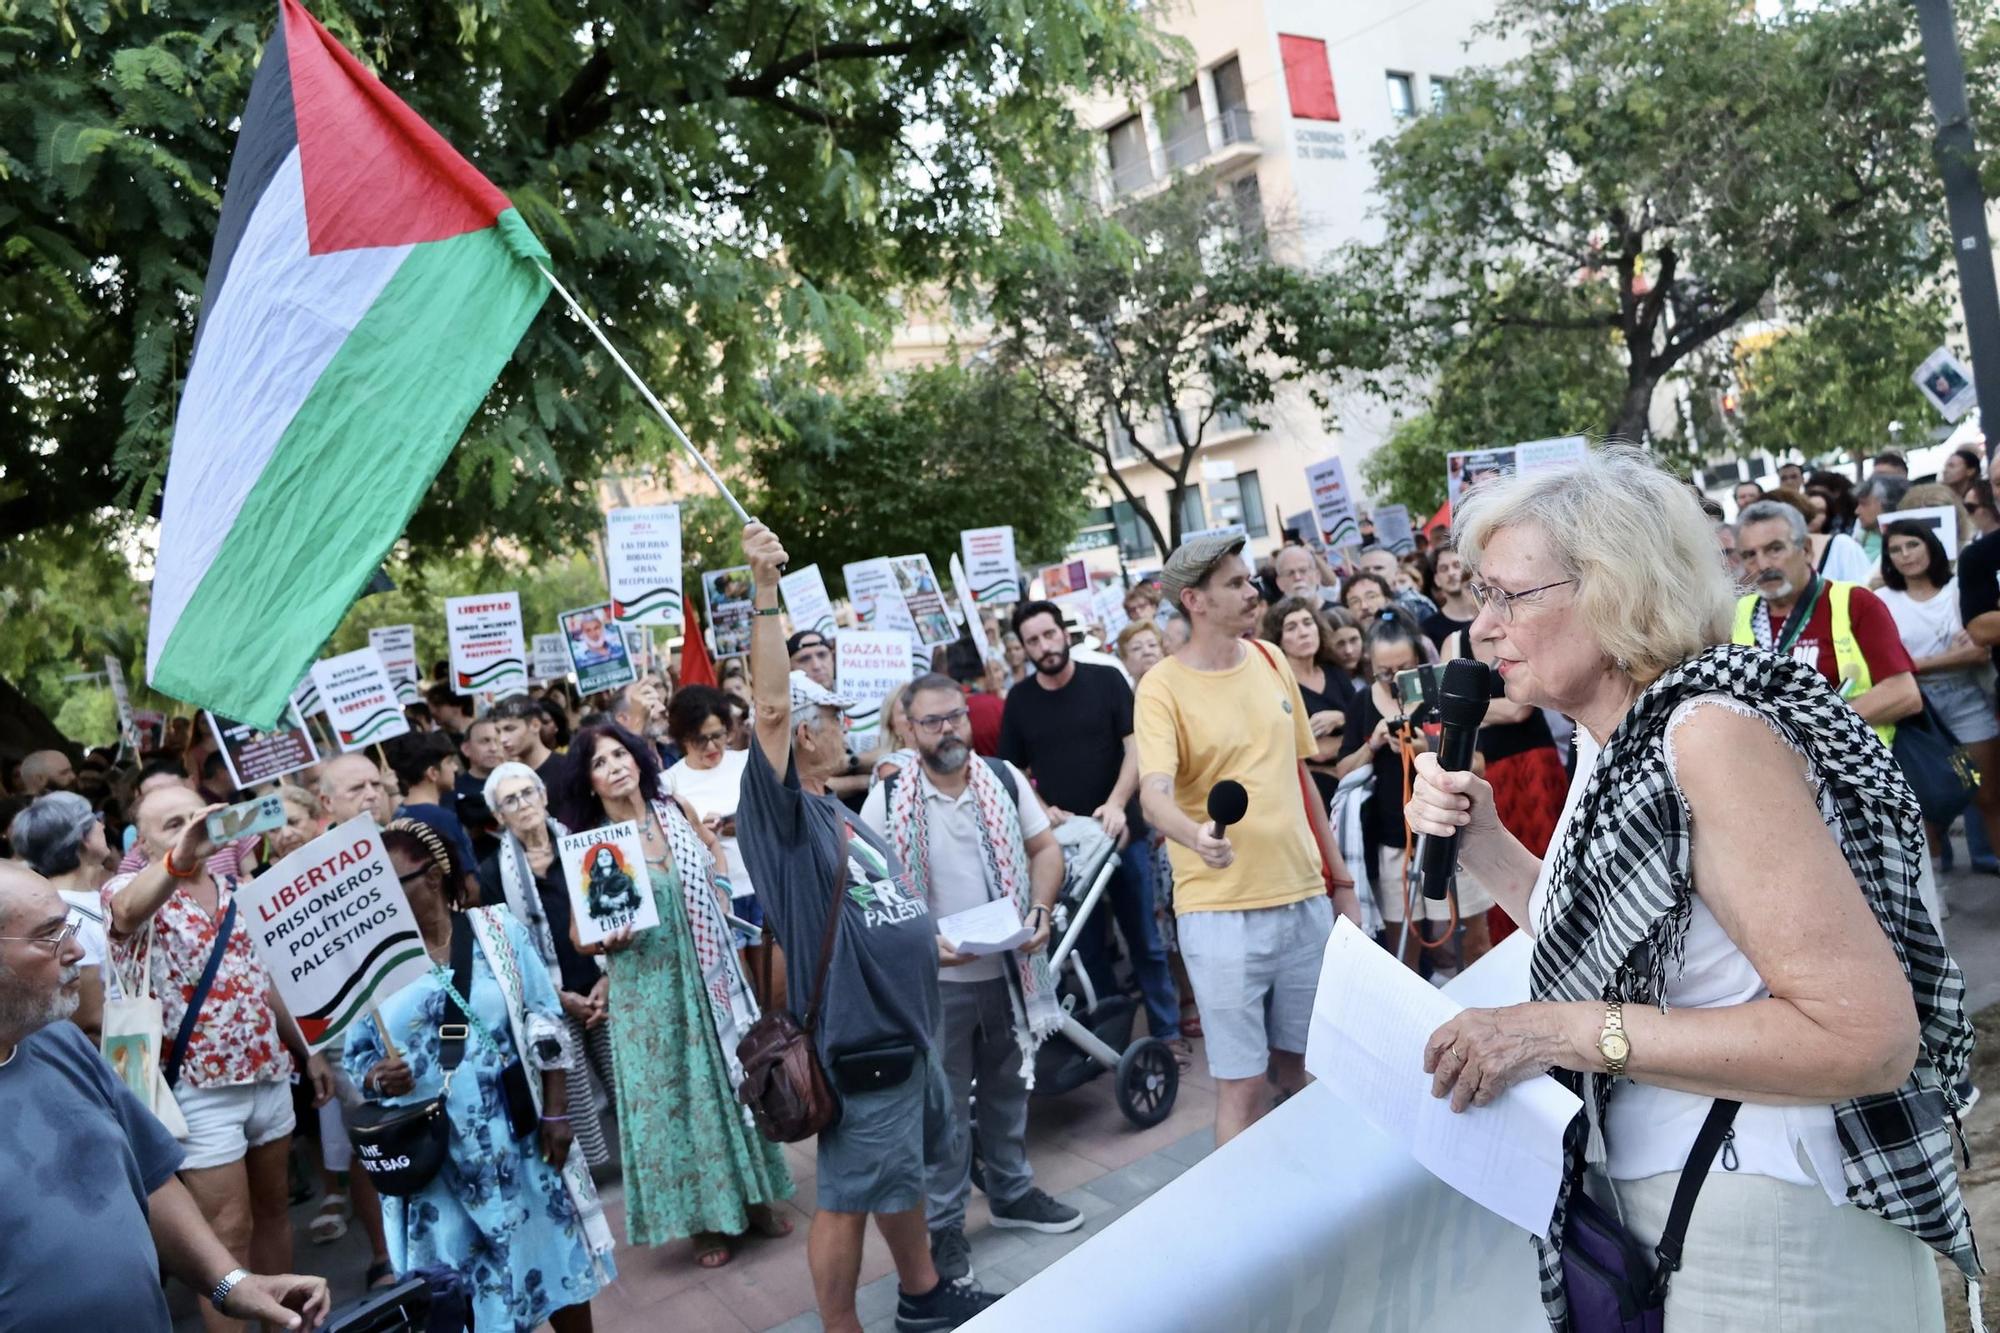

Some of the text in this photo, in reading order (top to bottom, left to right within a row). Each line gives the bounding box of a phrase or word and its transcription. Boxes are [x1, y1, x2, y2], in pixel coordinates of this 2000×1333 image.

[457, 602, 511, 615] LIBERTAD
[842, 643, 904, 655] GAZA ES
[842, 659, 907, 669] PALESTINA
[856, 679, 872, 688] de
[564, 825, 633, 852] PALESTINA
[257, 838, 373, 923] LIBERTAD
[263, 860, 385, 948] PRISIONEROS
[288, 887, 382, 957] POLÍTICOS
[600, 910, 637, 932] LIBRE
[290, 902, 399, 983] PALESTINOS
[359, 1144, 383, 1157] THE
[380, 1155, 411, 1172] BAG
